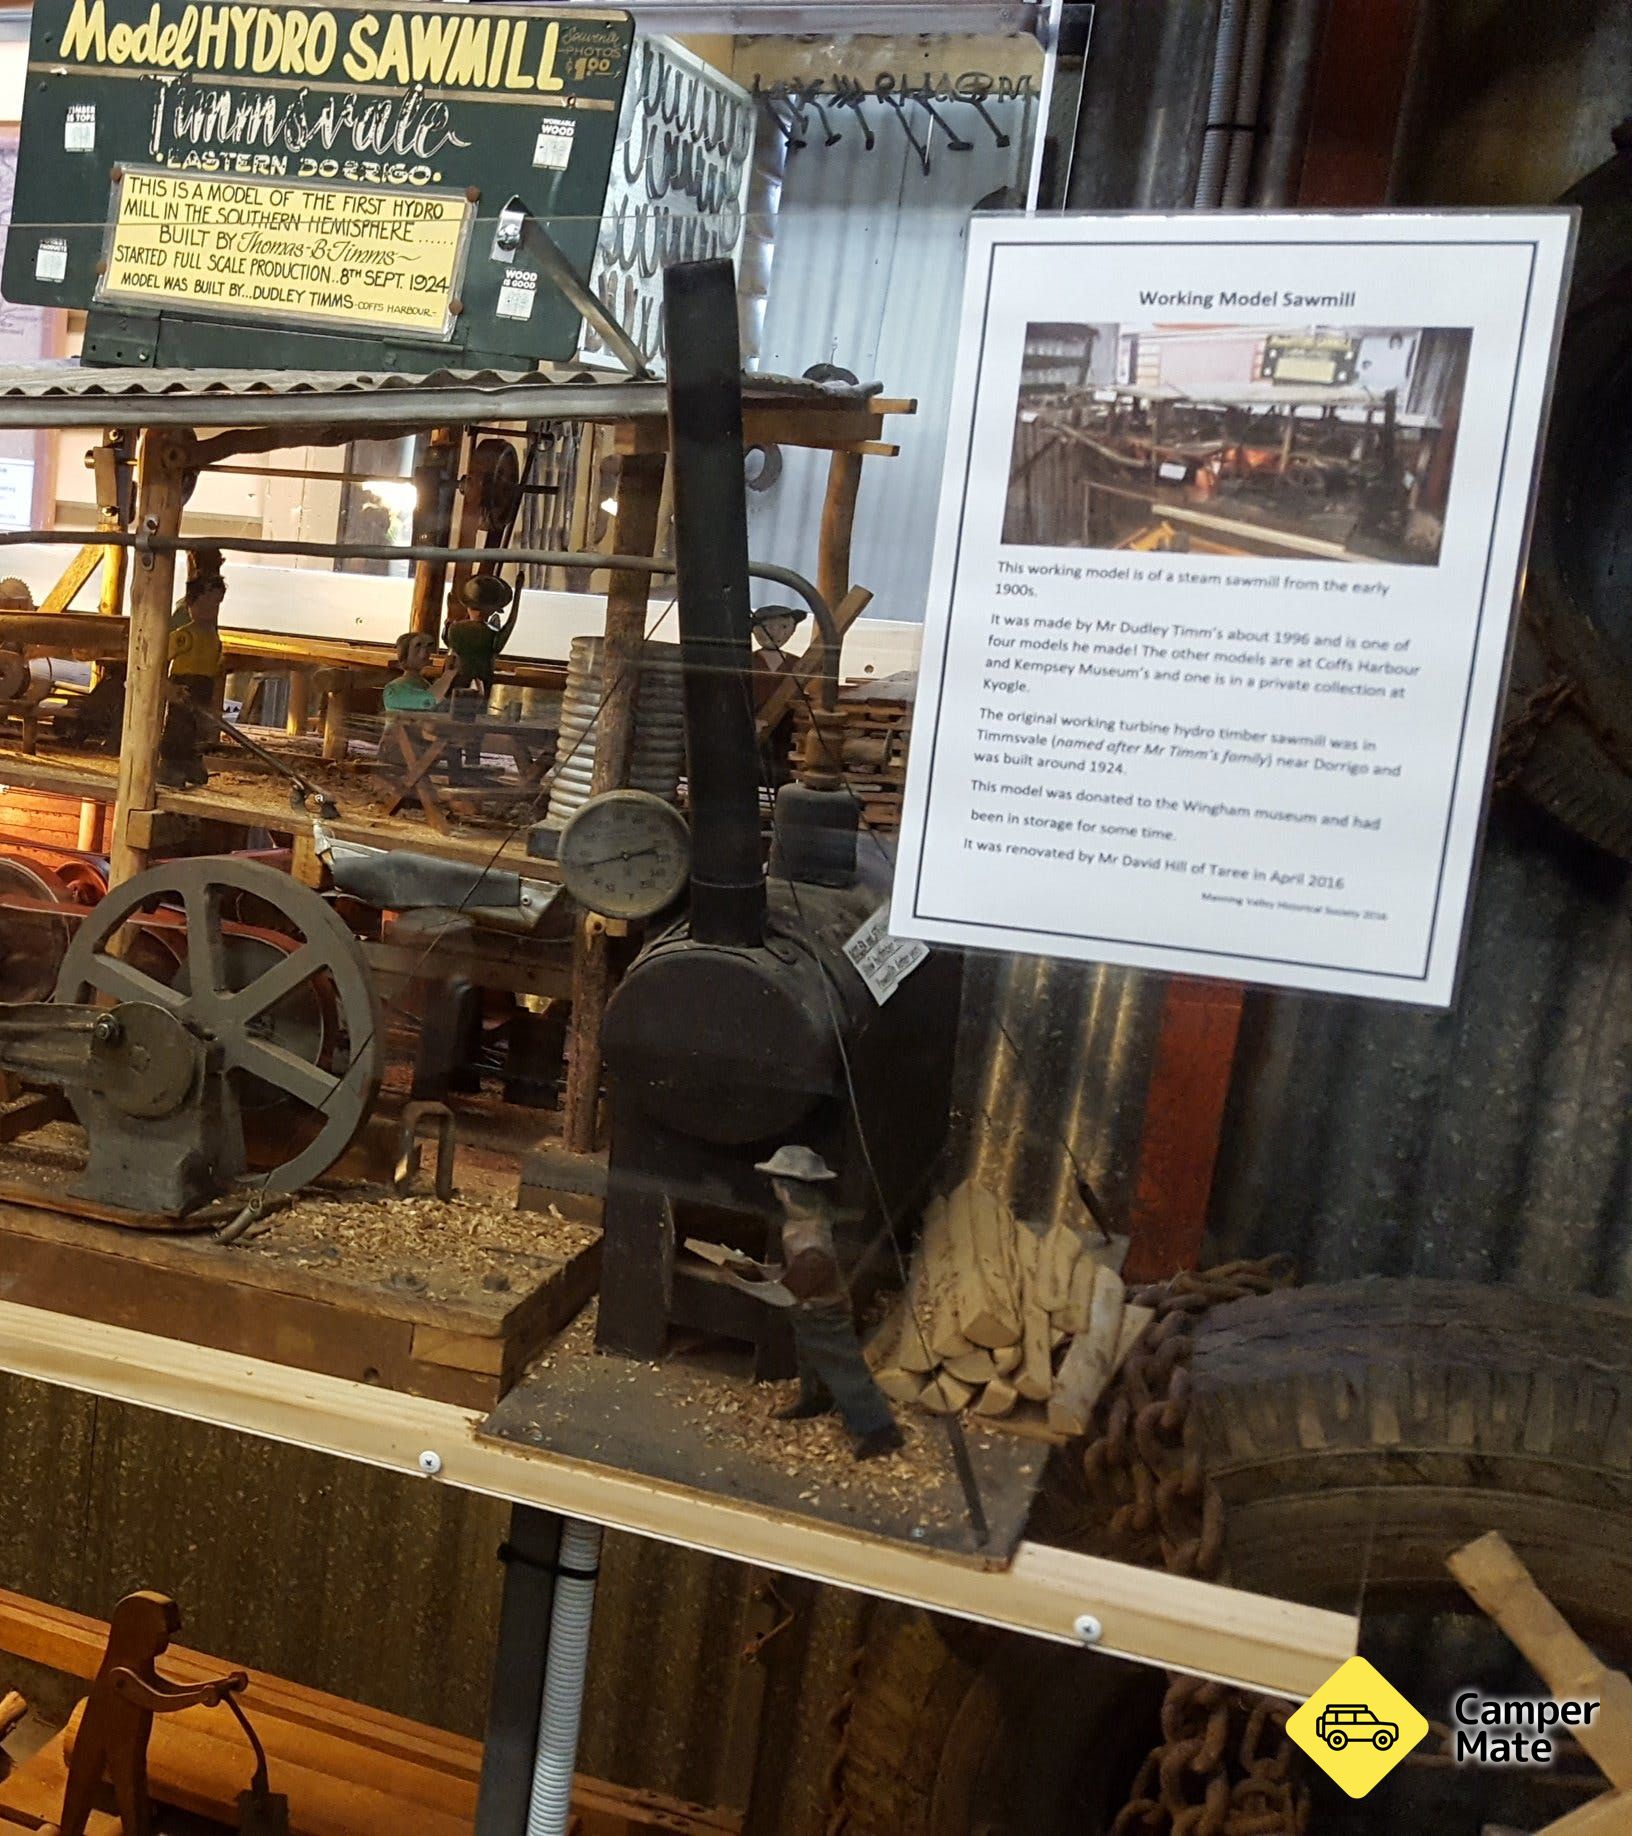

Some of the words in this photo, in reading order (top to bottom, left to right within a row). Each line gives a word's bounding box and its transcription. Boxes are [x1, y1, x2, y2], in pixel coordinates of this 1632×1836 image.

[60, 0, 198, 69] Model
[197, 5, 338, 76] HYDRO
[342, 13, 564, 91] SAWMILL
[139, 72, 471, 159] Timmsvale
[541, 124, 575, 137] WOOD
[167, 148, 288, 176] EASTERN
[123, 199, 159, 219] MILL
[164, 202, 179, 220] IN
[185, 203, 212, 224] THE
[216, 207, 301, 232] SOUTHERN
[129, 176, 167, 198] THIS
[172, 181, 189, 199] IS
[192, 183, 204, 200] A
[207, 183, 263, 206] MODEL
[269, 189, 294, 208] OF
[303, 192, 336, 211] THE
[343, 195, 386, 216] FIRST
[393, 200, 444, 220] HYDRO
[159, 224, 210, 247] BUILT
[216, 230, 237, 250] BY
[115, 245, 167, 267] STARTED
[173, 251, 202, 270] FULL
[207, 254, 247, 274] SCALE
[363, 270, 405, 289] SEPT.
[505, 269, 538, 281] WOOD
[511, 279, 536, 289] GOOD
[121, 272, 160, 289] MODEL
[163, 276, 188, 292] WAS
[193, 279, 225, 296] BUILT
[253, 285, 306, 303] DUDLEY
[310, 291, 354, 309] TIMMS
[1139, 290, 1214, 310] Working
[1218, 291, 1278, 307] Model
[1282, 291, 1356, 308] Sawmill
[995, 583, 1038, 598] 1900s.
[997, 560, 1024, 575] This
[1027, 563, 1082, 580] working
[1085, 567, 1130, 580] model
[1133, 569, 1144, 581] is
[1147, 568, 1164, 582] of
[1165, 571, 1175, 583] a
[1177, 572, 1222, 585] steam
[1225, 575, 1281, 588] sawmill
[1283, 575, 1320, 591] from
[1323, 579, 1349, 593] the
[1351, 581, 1391, 598] early
[990, 613, 1001, 626] It
[1003, 616, 1030, 628] was
[1033, 617, 1072, 630] made
[1075, 618, 1093, 634] by
[1096, 619, 1117, 632] Mr
[1119, 621, 1170, 639] Dudley
[1227, 628, 1270, 643] about
[1274, 631, 1310, 646] 1996
[1313, 634, 1342, 648] and
[1344, 636, 1357, 650] is
[1360, 639, 1390, 652] one
[1393, 638, 1412, 652] of
[988, 634, 1016, 648] four
[1019, 638, 1069, 652] models
[1072, 640, 1090, 654] he
[1141, 644, 1168, 659] The
[1170, 648, 1210, 661] other
[1213, 651, 1266, 666] models
[1269, 656, 1294, 668] are
[1297, 657, 1313, 669] at
[1315, 657, 1354, 672] Coffs
[1357, 660, 1422, 677] Harbour
[985, 657, 1011, 669] and
[1014, 658, 1076, 676] Kempsey
[1153, 669, 1181, 682] and
[1183, 672, 1211, 685] one
[1214, 672, 1226, 686] is
[1229, 674, 1243, 686] in
[1246, 677, 1256, 688] a
[1258, 678, 1311, 692] private
[1313, 681, 1386, 697] collection
[1389, 686, 1406, 699] at
[973, 752, 1000, 764] was
[1003, 752, 1034, 767] built
[1036, 757, 1086, 772] around
[963, 837, 973, 850] It
[976, 841, 1002, 853] was
[1005, 844, 1075, 861] renovated
[1077, 849, 1095, 865] by
[1098, 852, 1119, 864] Mr
[1122, 854, 1162, 870] David
[1164, 859, 1188, 873] Hill
[1190, 862, 1207, 875] of
[1209, 863, 1250, 880] Taree
[1252, 868, 1267, 881] in
[1269, 870, 1305, 886] April
[1308, 874, 1345, 891] 2016
